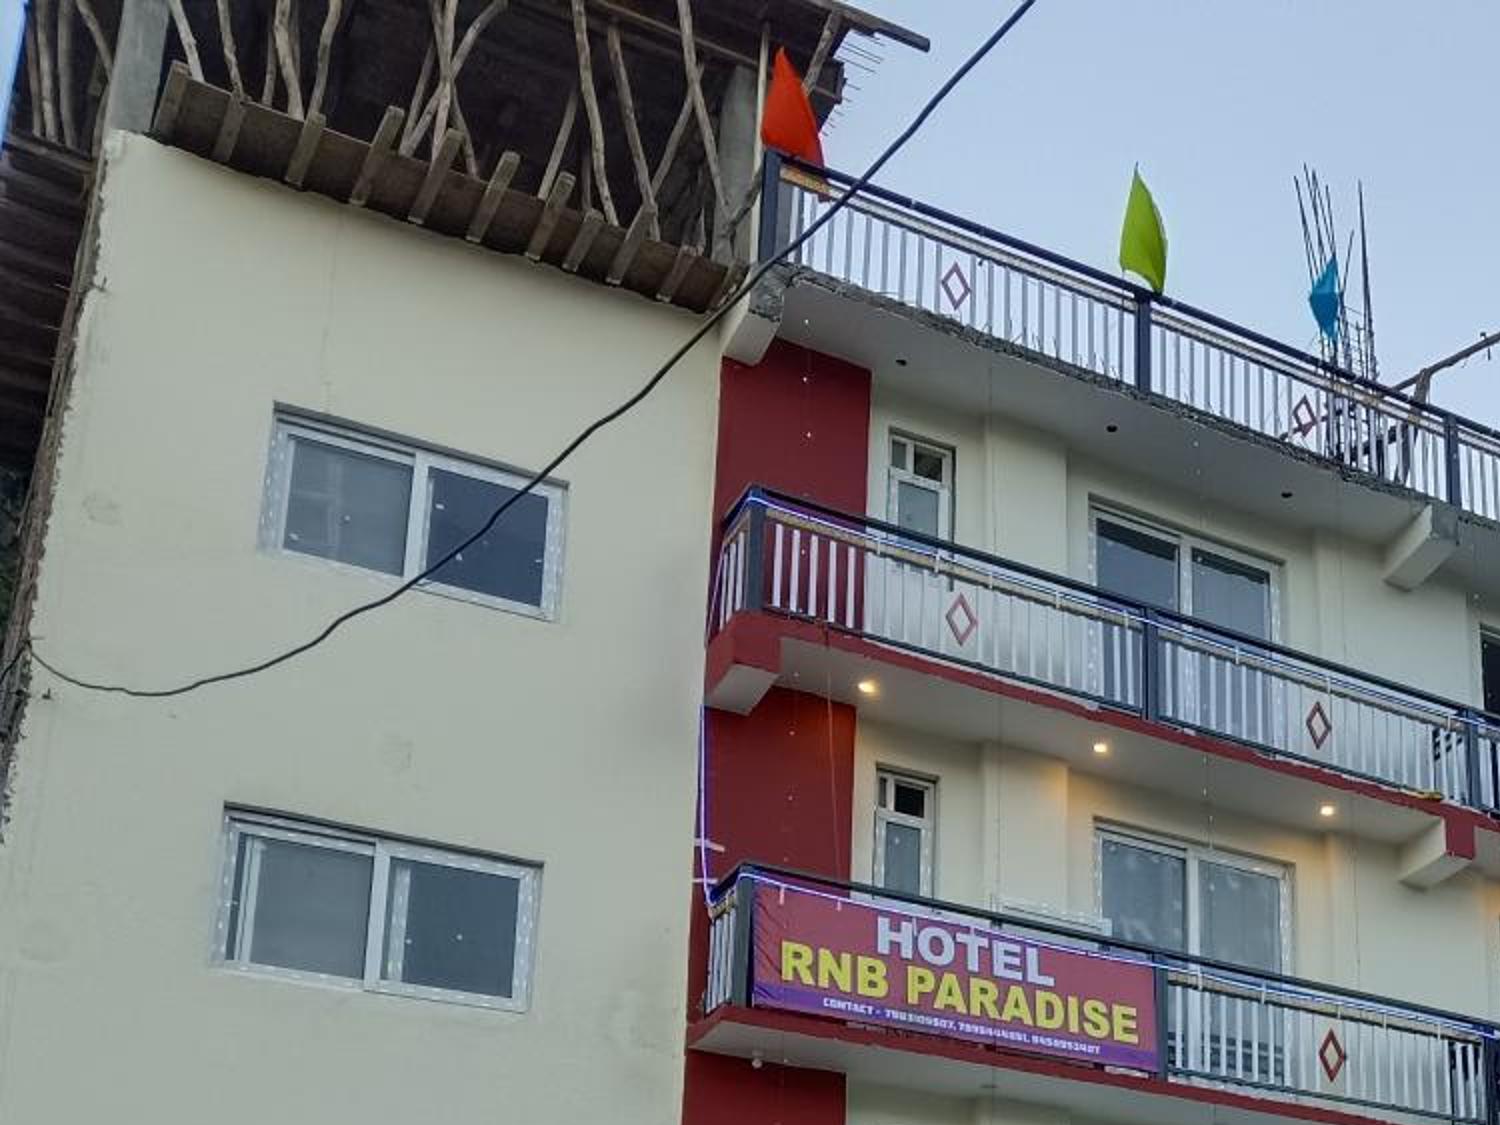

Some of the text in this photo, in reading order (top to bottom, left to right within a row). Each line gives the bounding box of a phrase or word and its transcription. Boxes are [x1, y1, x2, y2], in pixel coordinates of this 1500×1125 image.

[877, 916, 1056, 987] HOTEL
[781, 941, 1140, 1045] RNB PARADISE
[823, 997, 874, 1015] CONTACT
